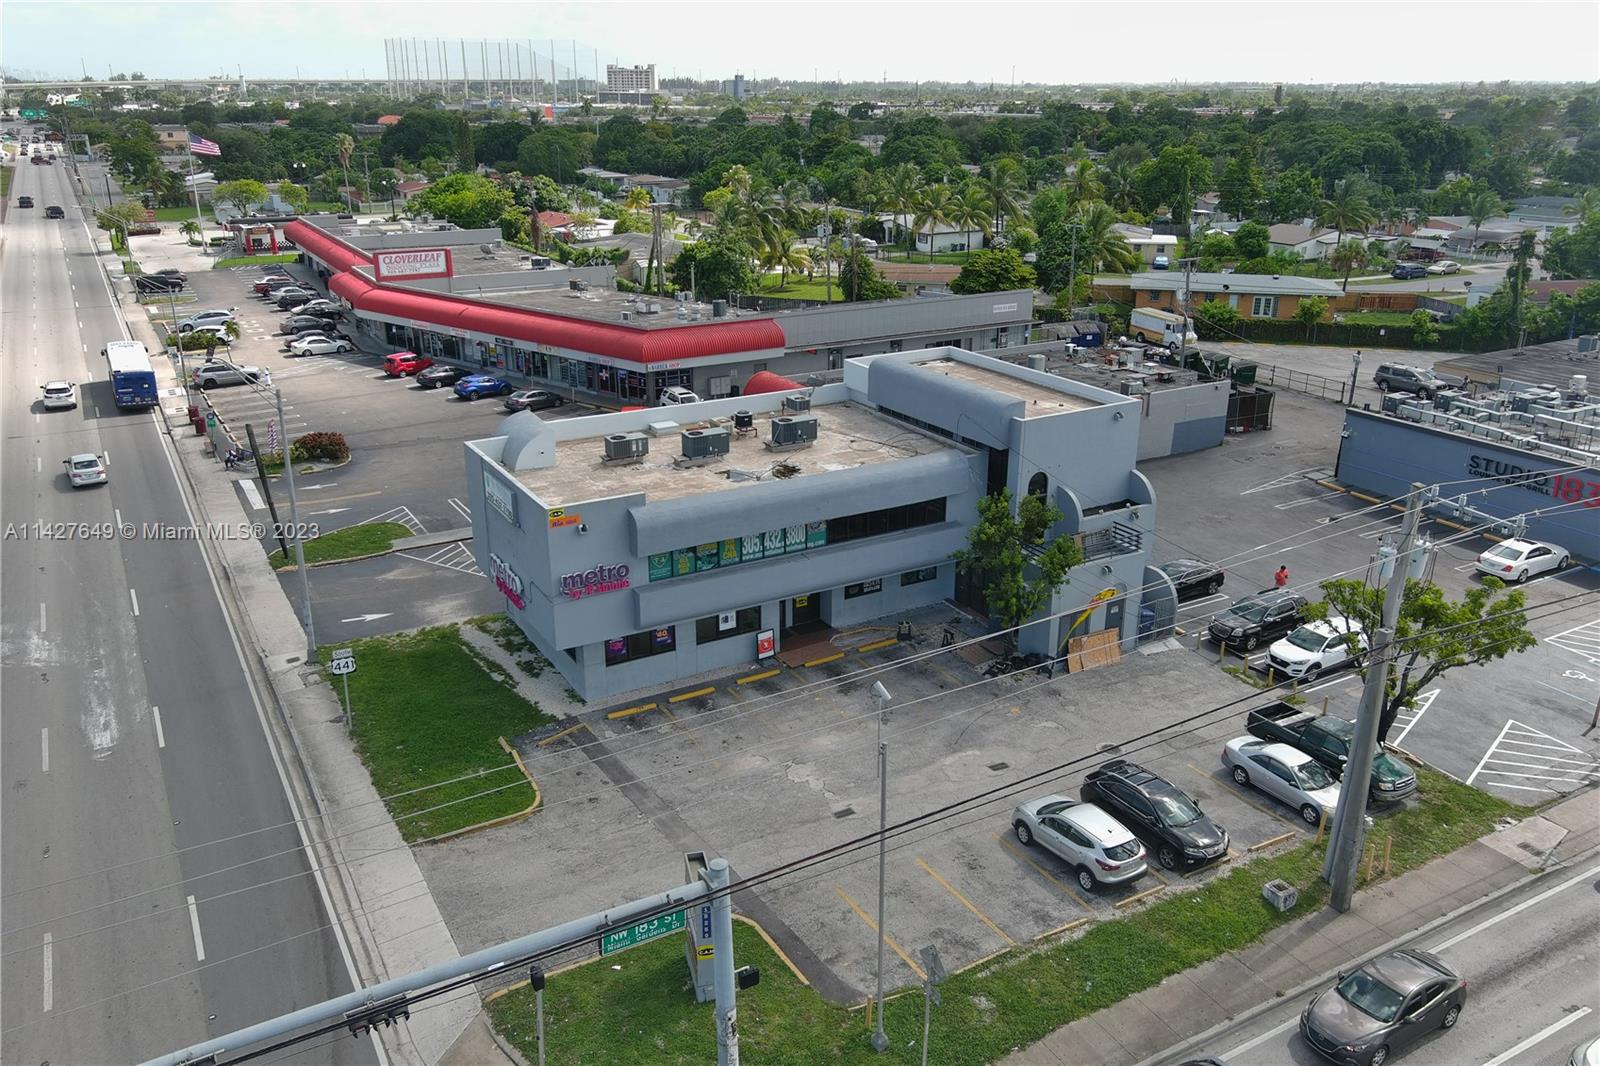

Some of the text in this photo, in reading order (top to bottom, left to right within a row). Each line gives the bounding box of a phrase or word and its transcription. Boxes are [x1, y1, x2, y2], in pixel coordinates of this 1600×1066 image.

[382, 252, 442, 265] CLOVERLEAF
[1469, 454, 1548, 486] STUDIO
[560, 563, 630, 589] metro
[334, 660, 355, 672] 441
[607, 938, 631, 952] Miami
[635, 927, 667, 942] Gardens
[610, 929, 628, 942] NW
[634, 919, 658, 934] 183
